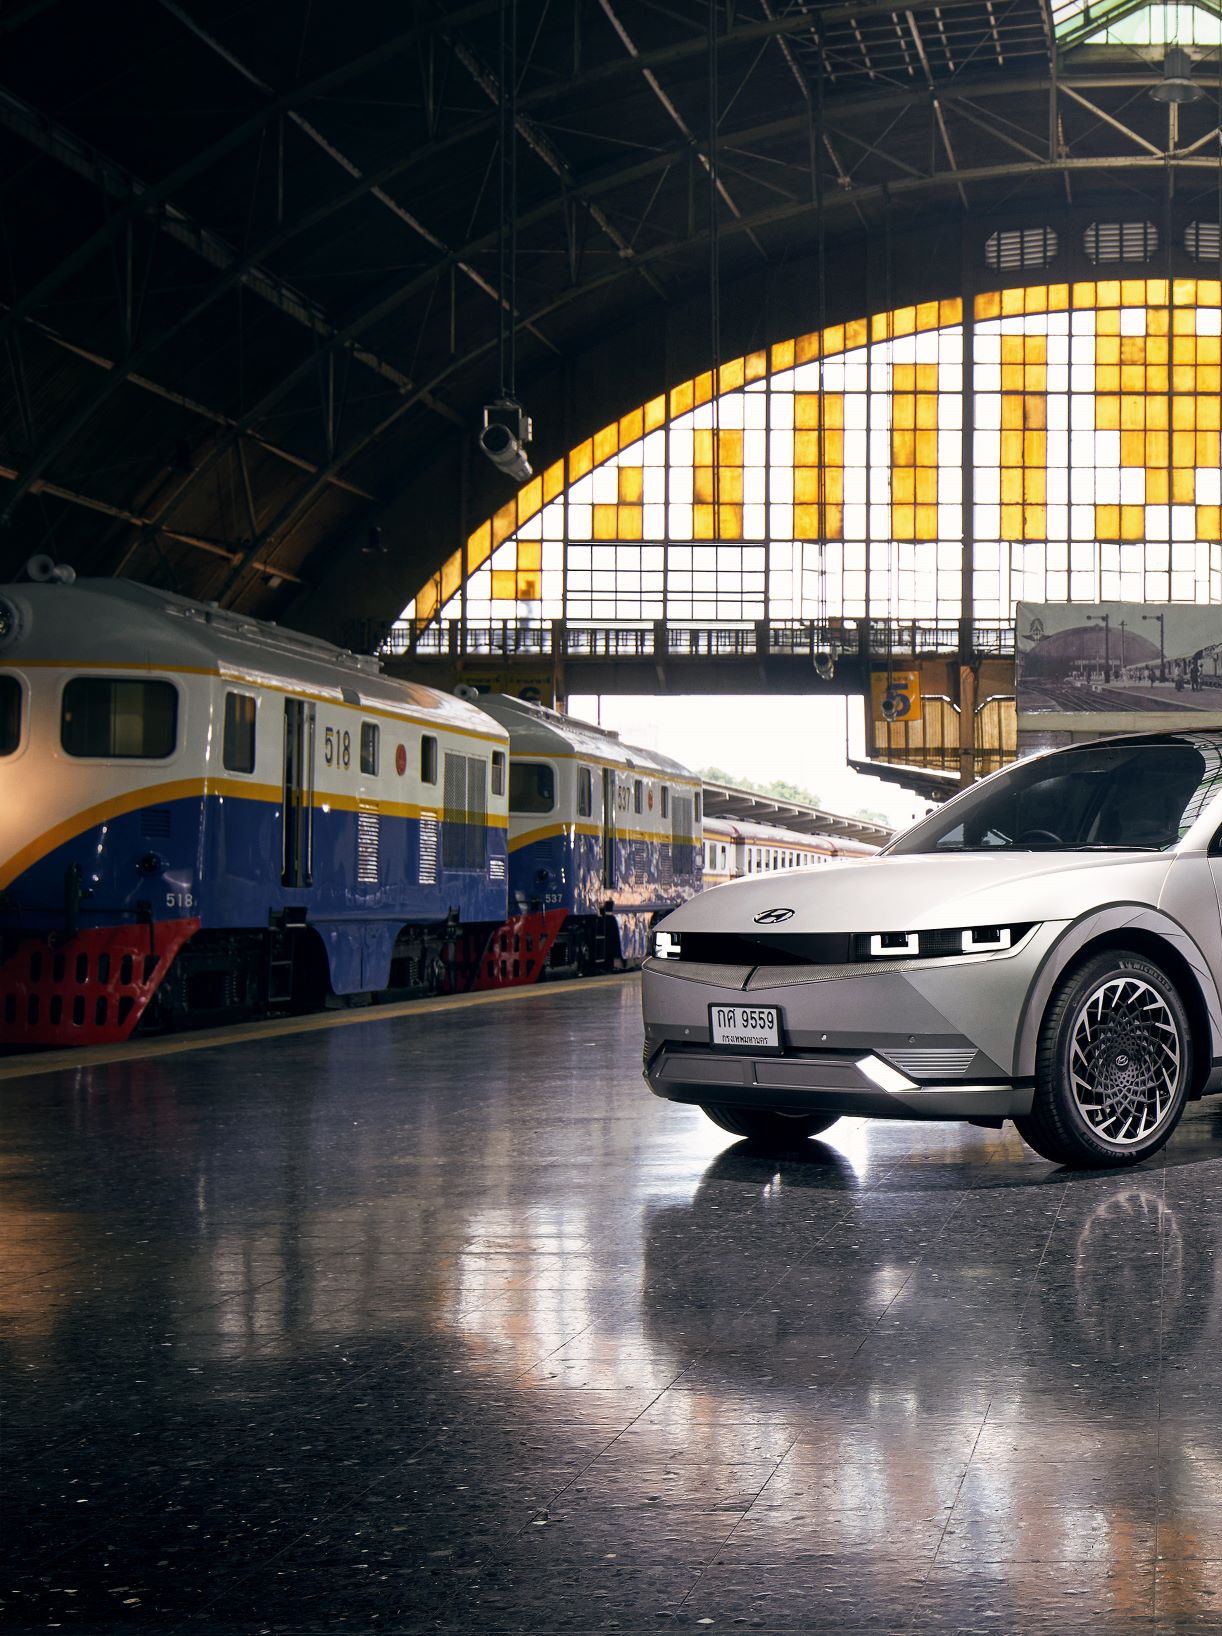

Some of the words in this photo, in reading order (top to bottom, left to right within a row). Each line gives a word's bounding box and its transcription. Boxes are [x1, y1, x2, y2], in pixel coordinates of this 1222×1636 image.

[887, 683, 910, 717] 5
[325, 726, 351, 770] 518
[618, 785, 630, 812] 537
[166, 893, 192, 907] 518
[545, 894, 562, 903] 537
[741, 1010, 774, 1030] 9559
